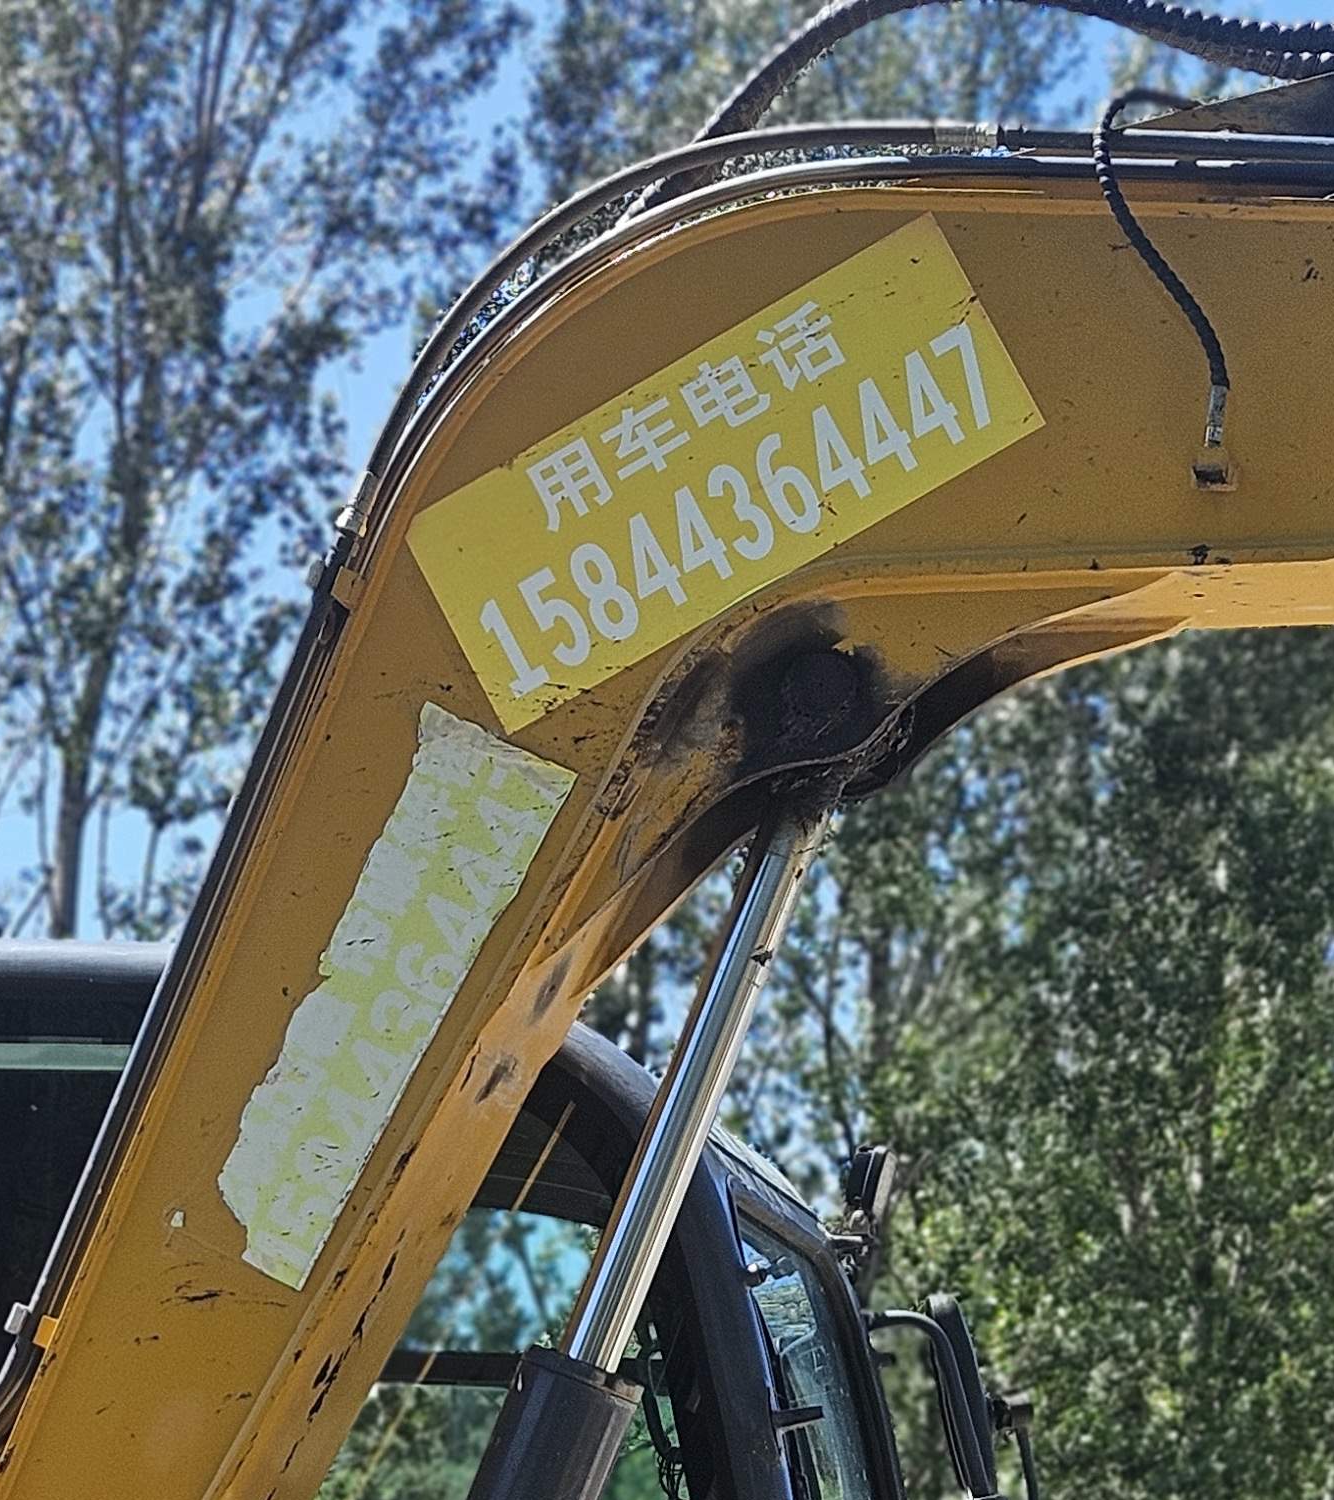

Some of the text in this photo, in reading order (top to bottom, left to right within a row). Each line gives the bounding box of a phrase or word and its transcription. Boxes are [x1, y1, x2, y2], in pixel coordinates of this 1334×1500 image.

[478, 322, 993, 699] 15844364447
[525, 300, 847, 533] 用车电话
